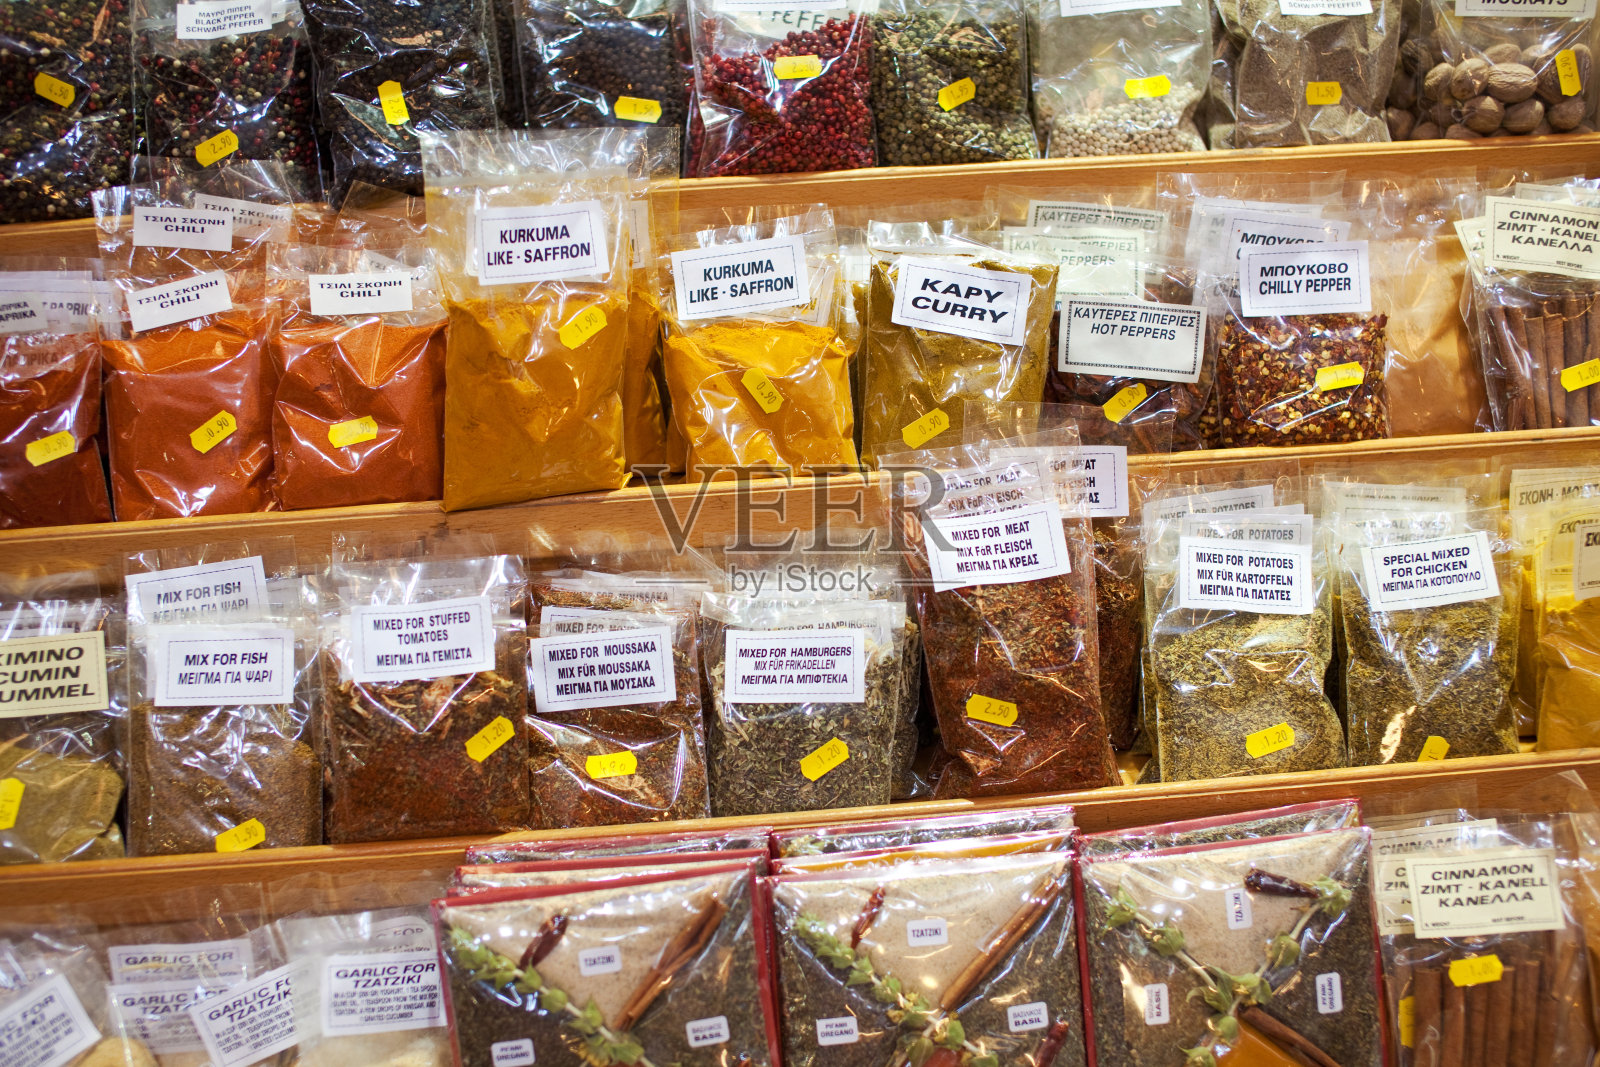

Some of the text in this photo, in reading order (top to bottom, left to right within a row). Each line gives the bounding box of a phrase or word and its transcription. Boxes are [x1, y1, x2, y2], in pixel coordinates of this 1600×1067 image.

[185, 18, 264, 33] SCHWARZ PFEFFER
[223, 12, 255, 22] PEPPER
[1315, 85, 1335, 99] 1.50
[143, 215, 226, 226] ΤΣΙΛΙ ΣΚΟΝΗ
[1039, 210, 1101, 224] ΚΑΥΤΕΡΕΣ
[1509, 210, 1599, 230] CINNAMON
[164, 224, 205, 234] CHILI
[499, 224, 571, 245] KURKUMA
[1496, 221, 1538, 233] ZIMT
[1511, 235, 1593, 254] ΚΑΝΕΛΛΑ
[487, 242, 591, 267] LIKE SAFFRON
[703, 258, 775, 282] KURKUMA
[137, 279, 219, 305] ΤΣΙΛΙ ΣΚΟΝΗ
[339, 289, 382, 298] CHILI
[356, 280, 402, 289] ΣΚΟΝΗ
[689, 275, 794, 304] LIKE SAFFRON
[1259, 277, 1351, 295] CHILLY PEPPER
[159, 293, 201, 309] CHILI
[911, 296, 1009, 324] CURRY
[1073, 307, 1196, 328] ΚΑΥΤΕΡΕΣ ΠΙΠΕΡΙΕΣ
[1091, 323, 1177, 341] HOT PEPPERS
[755, 380, 778, 405] 0.90
[1117, 386, 1140, 408] 0.90
[918, 414, 942, 436] 0.90
[1518, 488, 1554, 506] ΣΚΟΝΗ
[952, 520, 1030, 542] MIXED FOR MEAT
[1248, 529, 1294, 541] POTATOES
[956, 538, 1033, 558] MIX FLEISCH
[1382, 546, 1471, 566] SPECIAL MIXED
[956, 553, 1040, 574] ΜΕΙΓΜΑ ΓΙΑ ΚΡΕΑΣ
[1195, 551, 1294, 570] MIXED FOR POTATOES
[1391, 559, 1468, 579] FOR CHICKEN
[1197, 568, 1293, 587] MIX FÜR KARTOFFELN
[1382, 570, 1481, 593] ΜΕΙΓΜΑ ΓΙΑ ΚΟΤΟΠΟΥΛΟ
[156, 581, 241, 605] MIX FOR FISH
[1199, 583, 1291, 601] ΜΕΙΓΜΑ ΓΙΑ ΠΑΤΑΤΕΣ
[220, 597, 249, 612] ΨΑΡΙ
[373, 611, 471, 631] MIXED FOR STUFFED
[555, 622, 584, 634] MIXED
[397, 629, 449, 645] TOMATOES
[184, 651, 269, 667] MIX FOR FISH
[376, 647, 473, 667] ΜΕΙΓΜΑ ΓΙΑ ΓΕΜΙΣΤΑ
[548, 640, 657, 662] MIXED FOR MOUSSAKA
[738, 646, 852, 659] MIXED FOR HAMBURGERS
[557, 659, 651, 680] MIX FÜR MOUSSAKA
[753, 658, 836, 671] MIX FÜR FRIKADELLEN
[177, 669, 273, 685] ΜΕΙΓΜΑ ΓΙΑ ΨΑΡΙ
[556, 675, 656, 697] ΜΕΙΓΜΑ ΓΙΑ ΜΟΥΣΑΚΑ
[741, 673, 848, 685] ΜΕΙΓΜΑ ΓΙΑ ΜΠΙΦΤΕΚΙΑ
[984, 700, 1011, 719] 2.50
[1263, 730, 1289, 750] 1.20
[1431, 863, 1534, 882] CINNAMON
[1420, 884, 1463, 895] ZIMT
[1479, 877, 1548, 892] KANELL
[1438, 891, 1534, 908] ΚΑΝΕΛΛΑ
[911, 927, 942, 939] TZATZIKI
[335, 963, 436, 979] GARLIC FOR
[353, 974, 422, 989] TZATZIKI
[123, 993, 188, 1007] GARLIC
[208, 987, 270, 1021] GARLIC
[1014, 1017, 1043, 1027] BASIL
[820, 1028, 854, 1038] OREGANO
